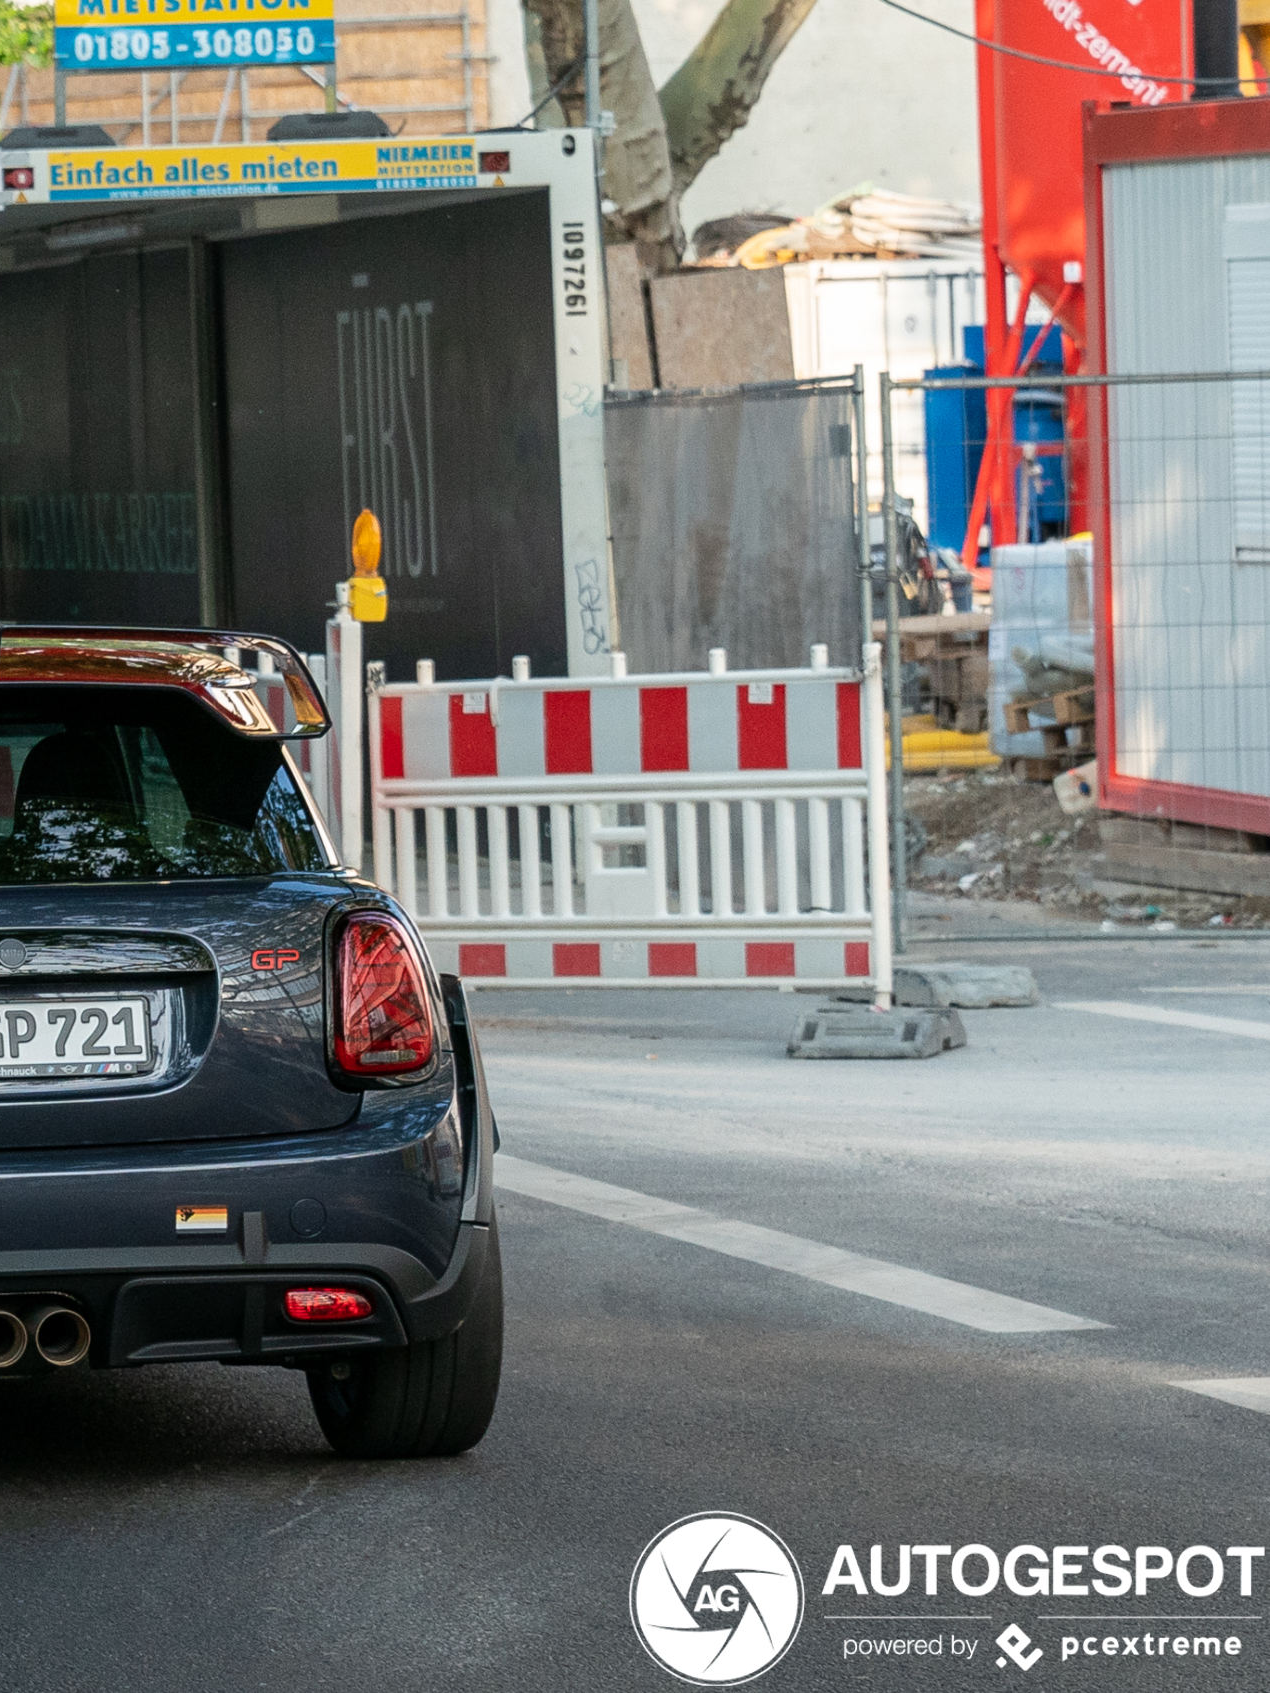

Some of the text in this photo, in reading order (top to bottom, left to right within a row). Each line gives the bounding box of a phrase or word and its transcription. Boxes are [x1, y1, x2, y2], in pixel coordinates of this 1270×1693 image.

[376, 145, 474, 163] NIEMEIER
[50, 155, 339, 186] Einfach alles mieten
[378, 163, 474, 177] MIETSTATION
[109, 183, 280, 199] www.niemeier-mietstation.de
[562, 222, 587, 316] 1097261
[251, 949, 300, 971] GP
[47, 1007, 143, 1057] 721
